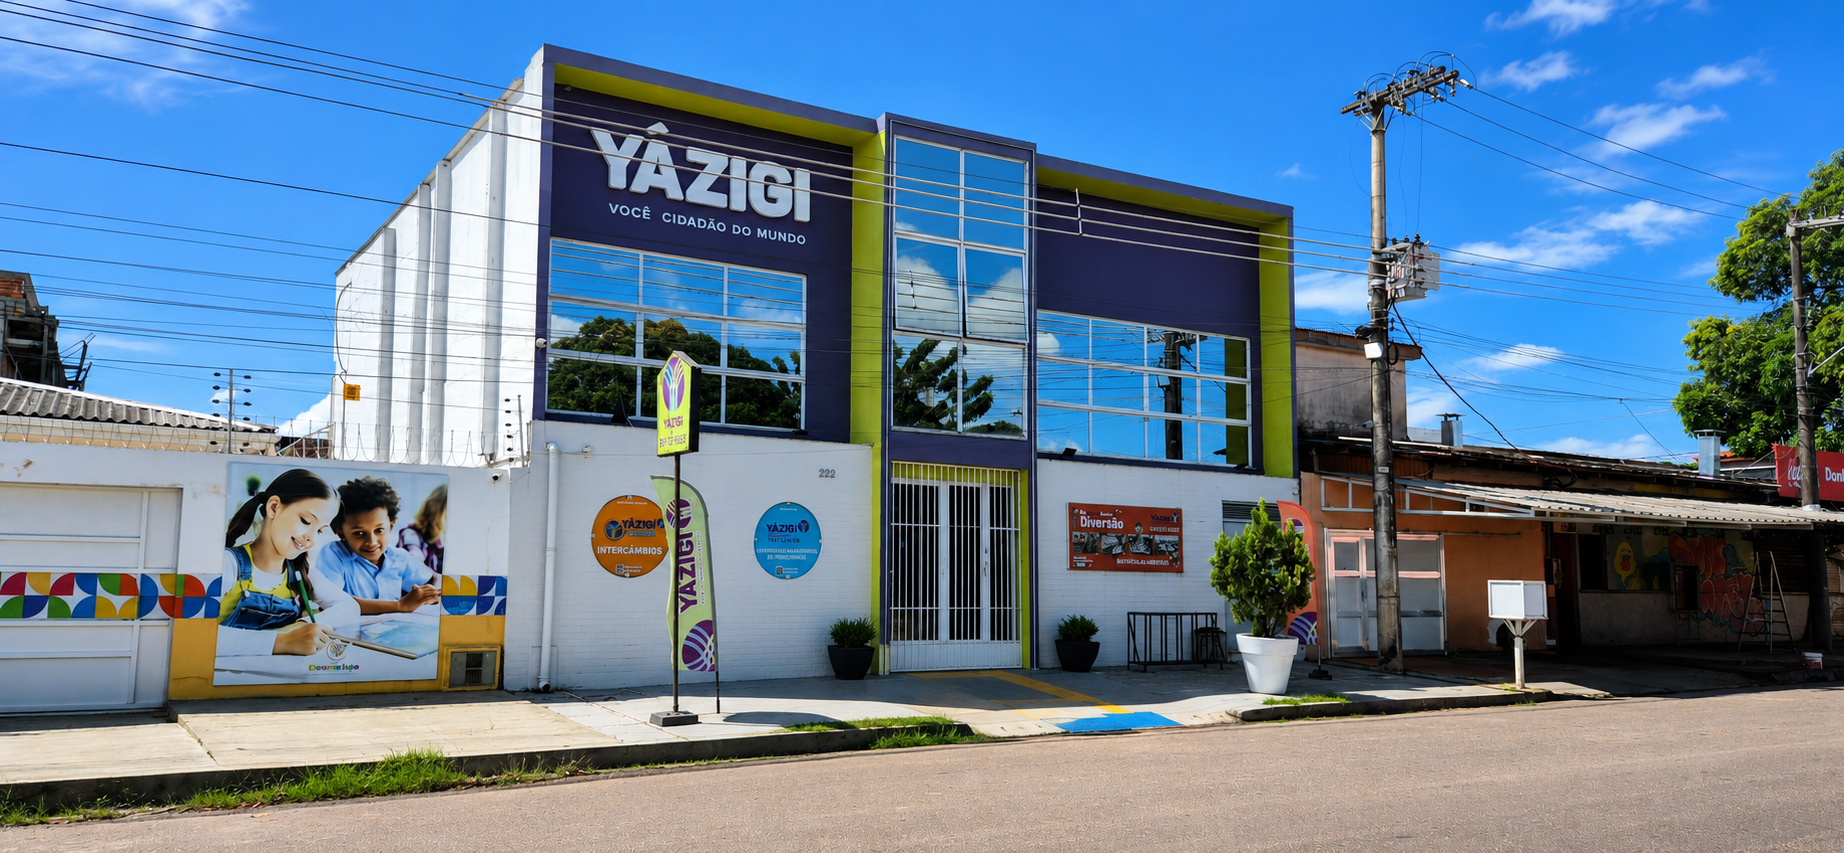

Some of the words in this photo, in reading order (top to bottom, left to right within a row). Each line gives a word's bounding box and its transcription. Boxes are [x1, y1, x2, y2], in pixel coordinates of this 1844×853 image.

[608, 202, 651, 220] VOCÊ
[662, 212, 727, 232] CIDADÃO
[732, 224, 752, 237] DO
[757, 227, 807, 245] MUNDO
[818, 468, 836, 479] 222
[1080, 515, 1124, 529] Diversão
